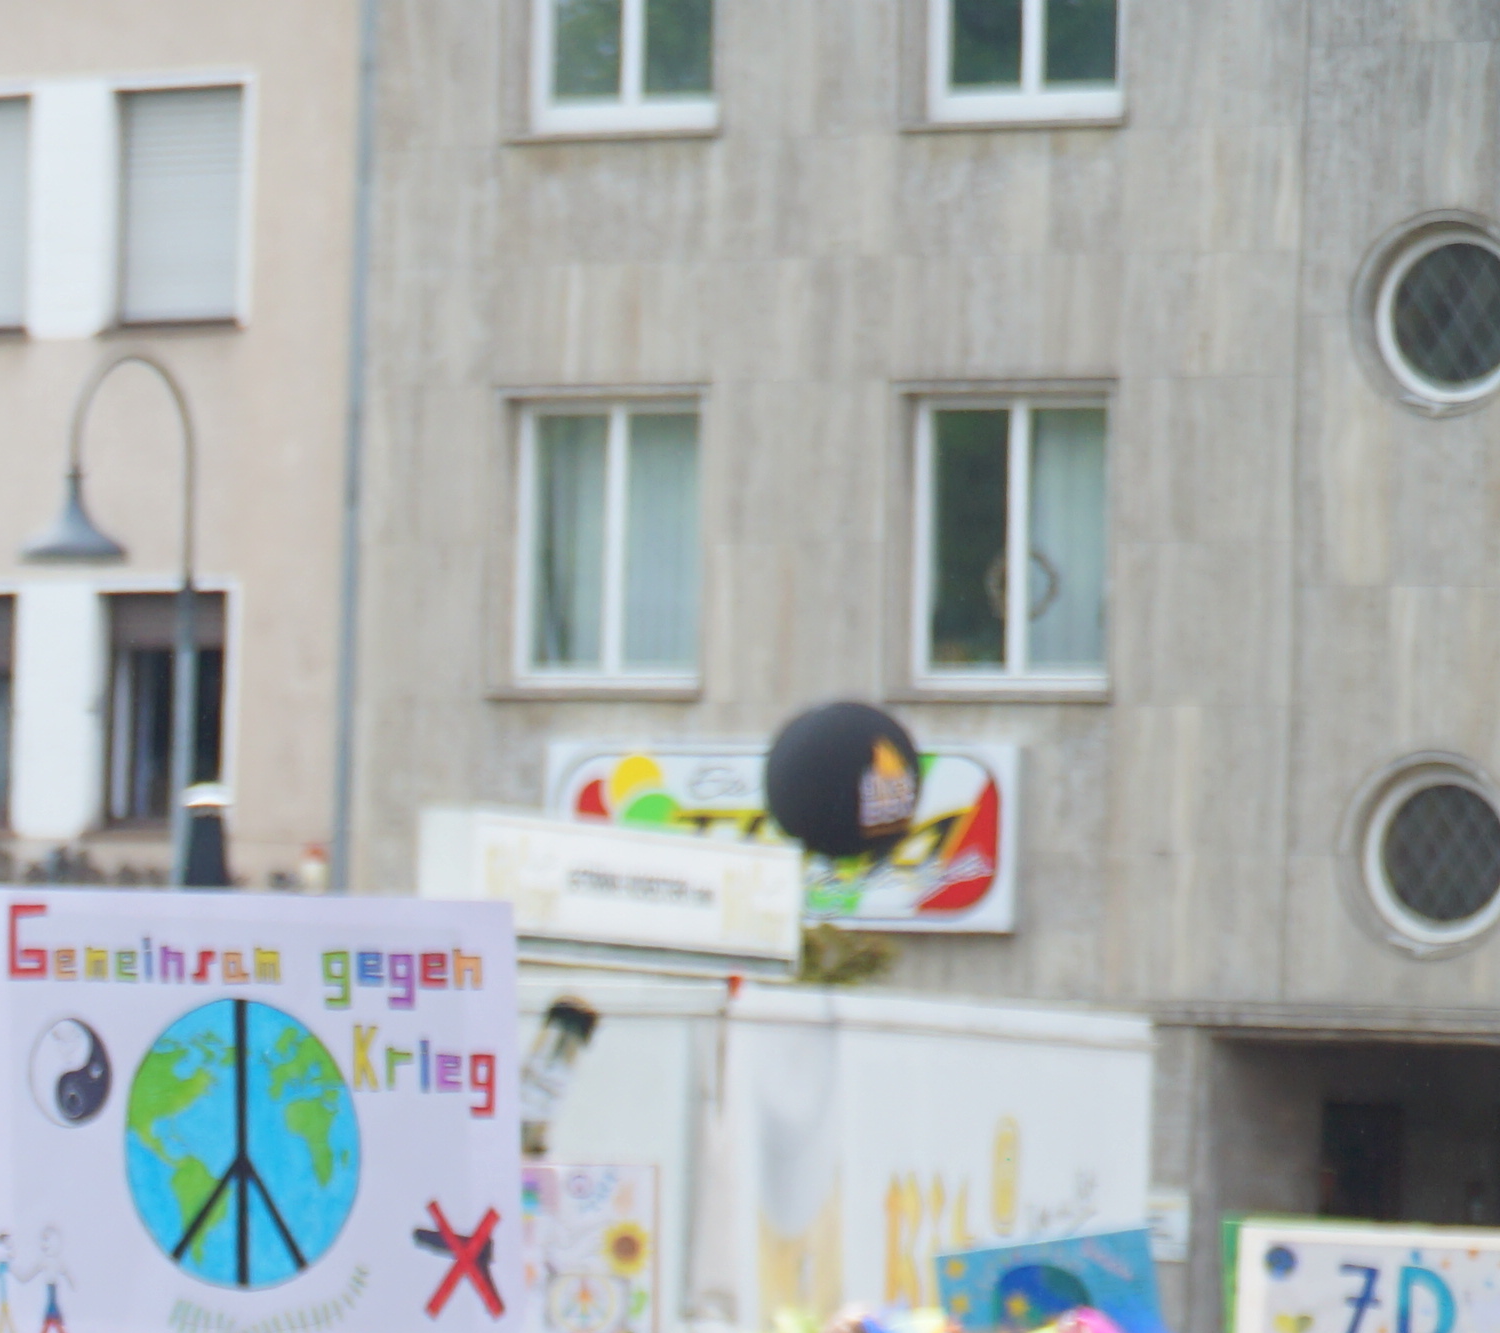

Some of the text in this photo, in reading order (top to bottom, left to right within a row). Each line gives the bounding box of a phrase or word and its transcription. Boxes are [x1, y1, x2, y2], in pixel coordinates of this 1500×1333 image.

[7, 903, 484, 1010] Gemeinsam gegen
[352, 1023, 498, 1119] Krieg
